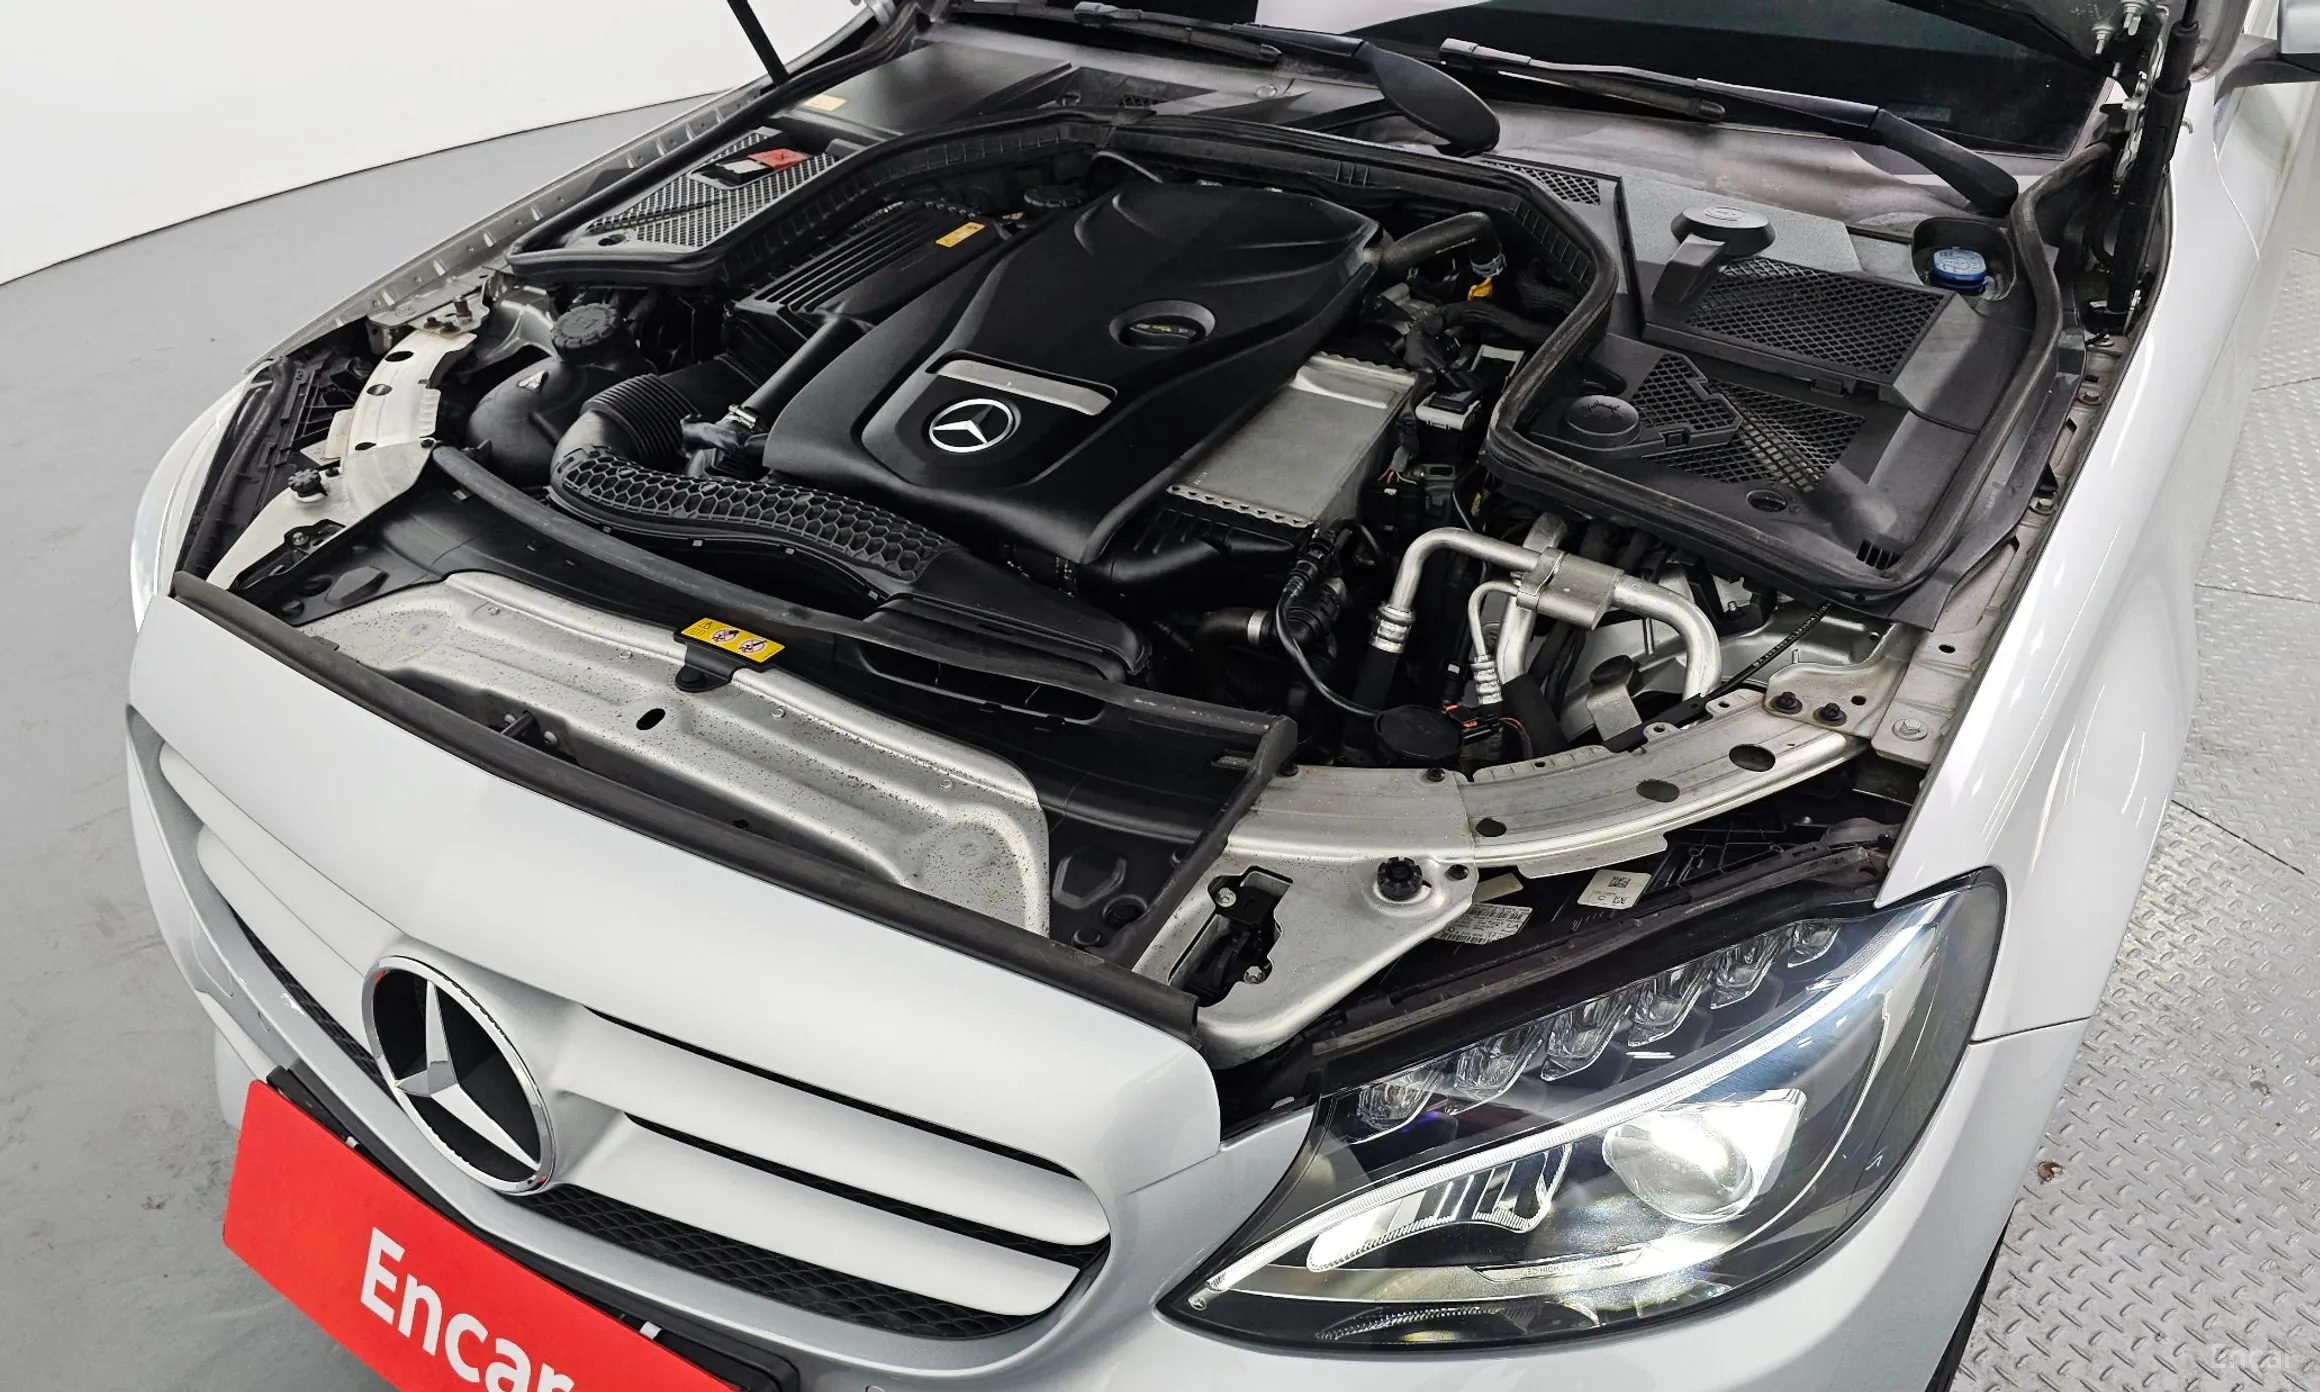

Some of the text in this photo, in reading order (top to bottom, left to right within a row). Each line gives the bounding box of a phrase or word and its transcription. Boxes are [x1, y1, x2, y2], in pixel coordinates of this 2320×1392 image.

[360, 1226, 575, 1392] Encar
[1540, 1265, 1560, 1274] HIGH
[1562, 1257, 1622, 1271] PERFRMANCE
